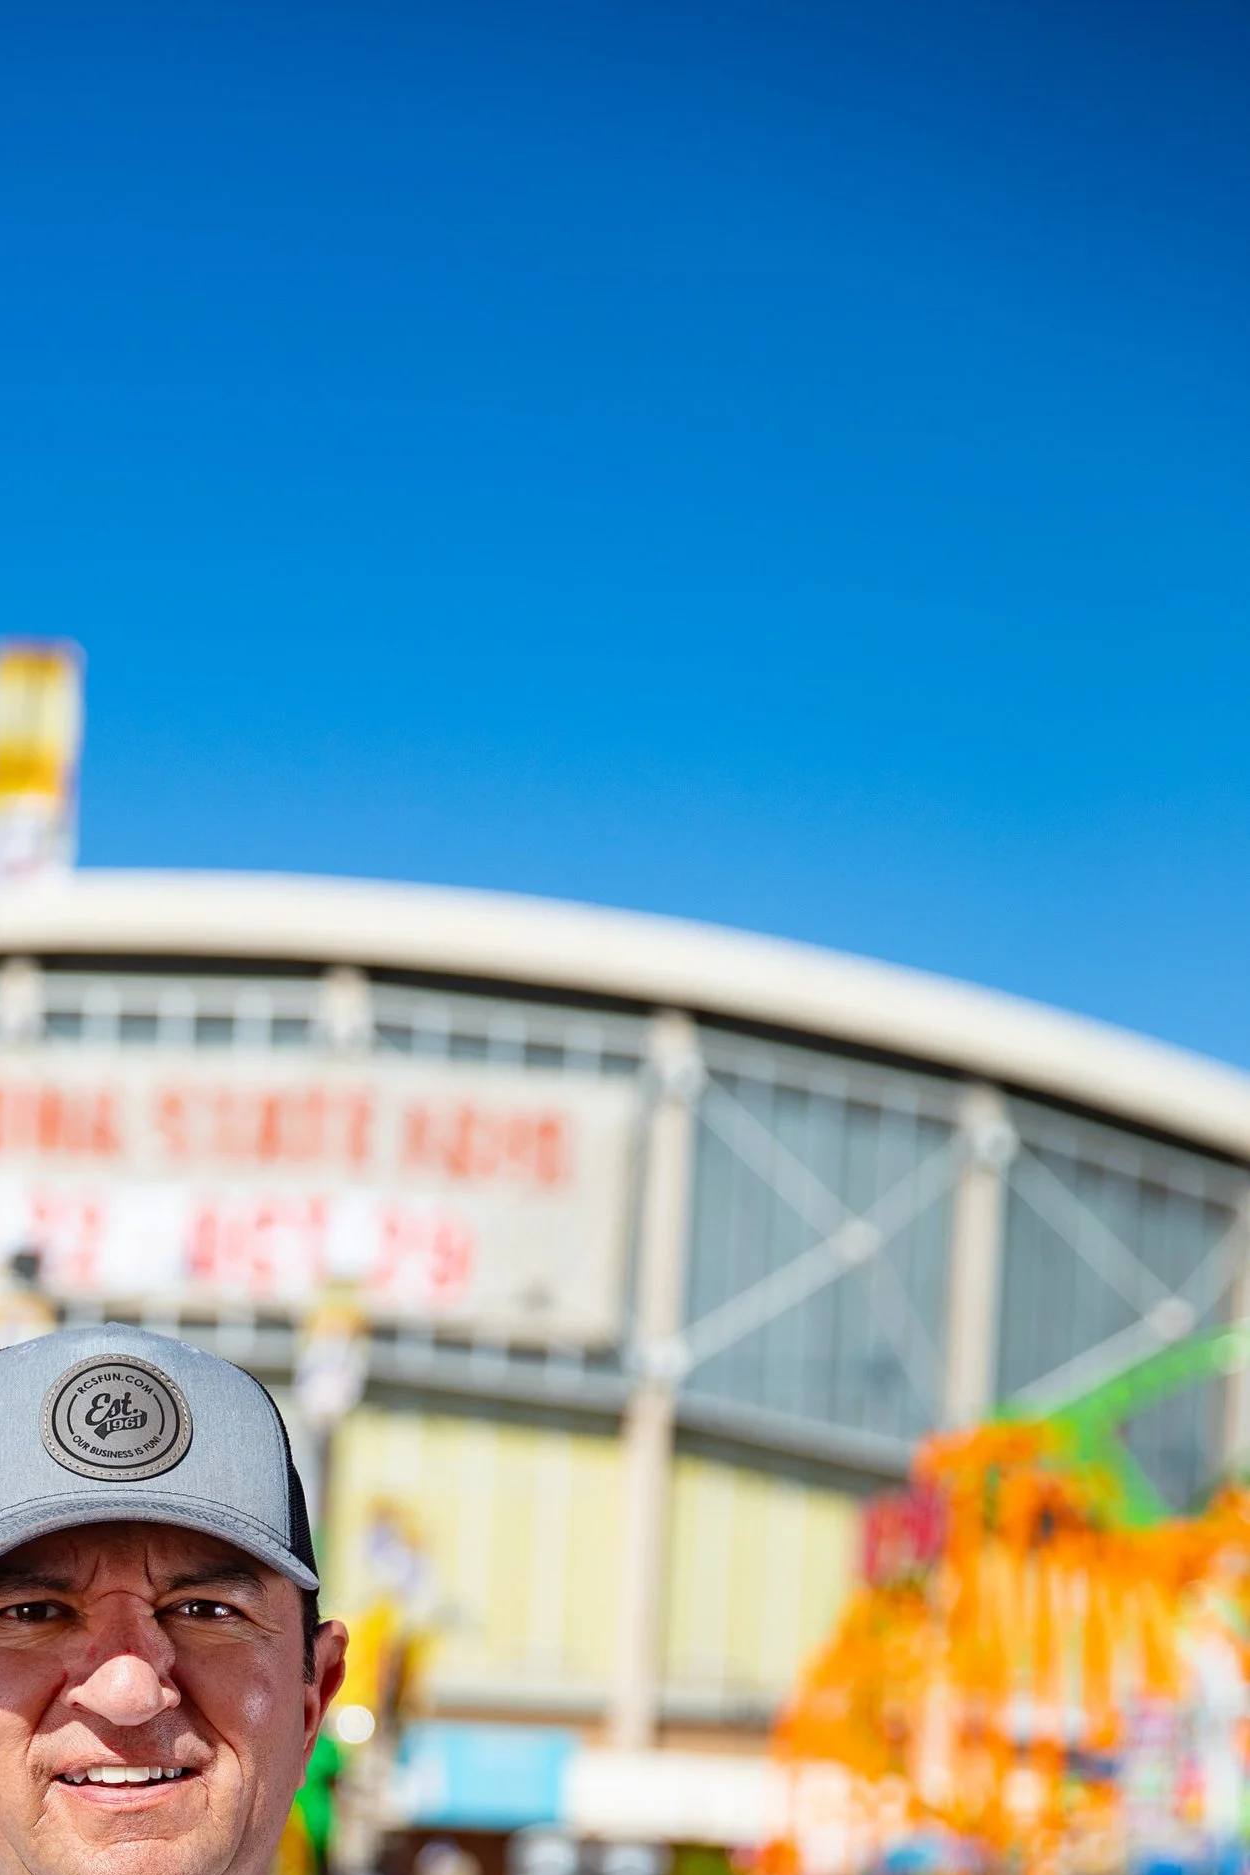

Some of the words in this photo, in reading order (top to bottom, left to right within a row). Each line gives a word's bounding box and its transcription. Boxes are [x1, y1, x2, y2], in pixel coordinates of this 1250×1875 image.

[77, 1373, 154, 1395] RCSFUN.COM
[84, 1391, 139, 1427] Est.
[106, 1416, 143, 1432] 1961
[72, 1434, 90, 1451] OUR
[89, 1445, 134, 1459] BUSINESS
[134, 1447, 144, 1456] IS
[143, 1435, 162, 1453] FUN!
